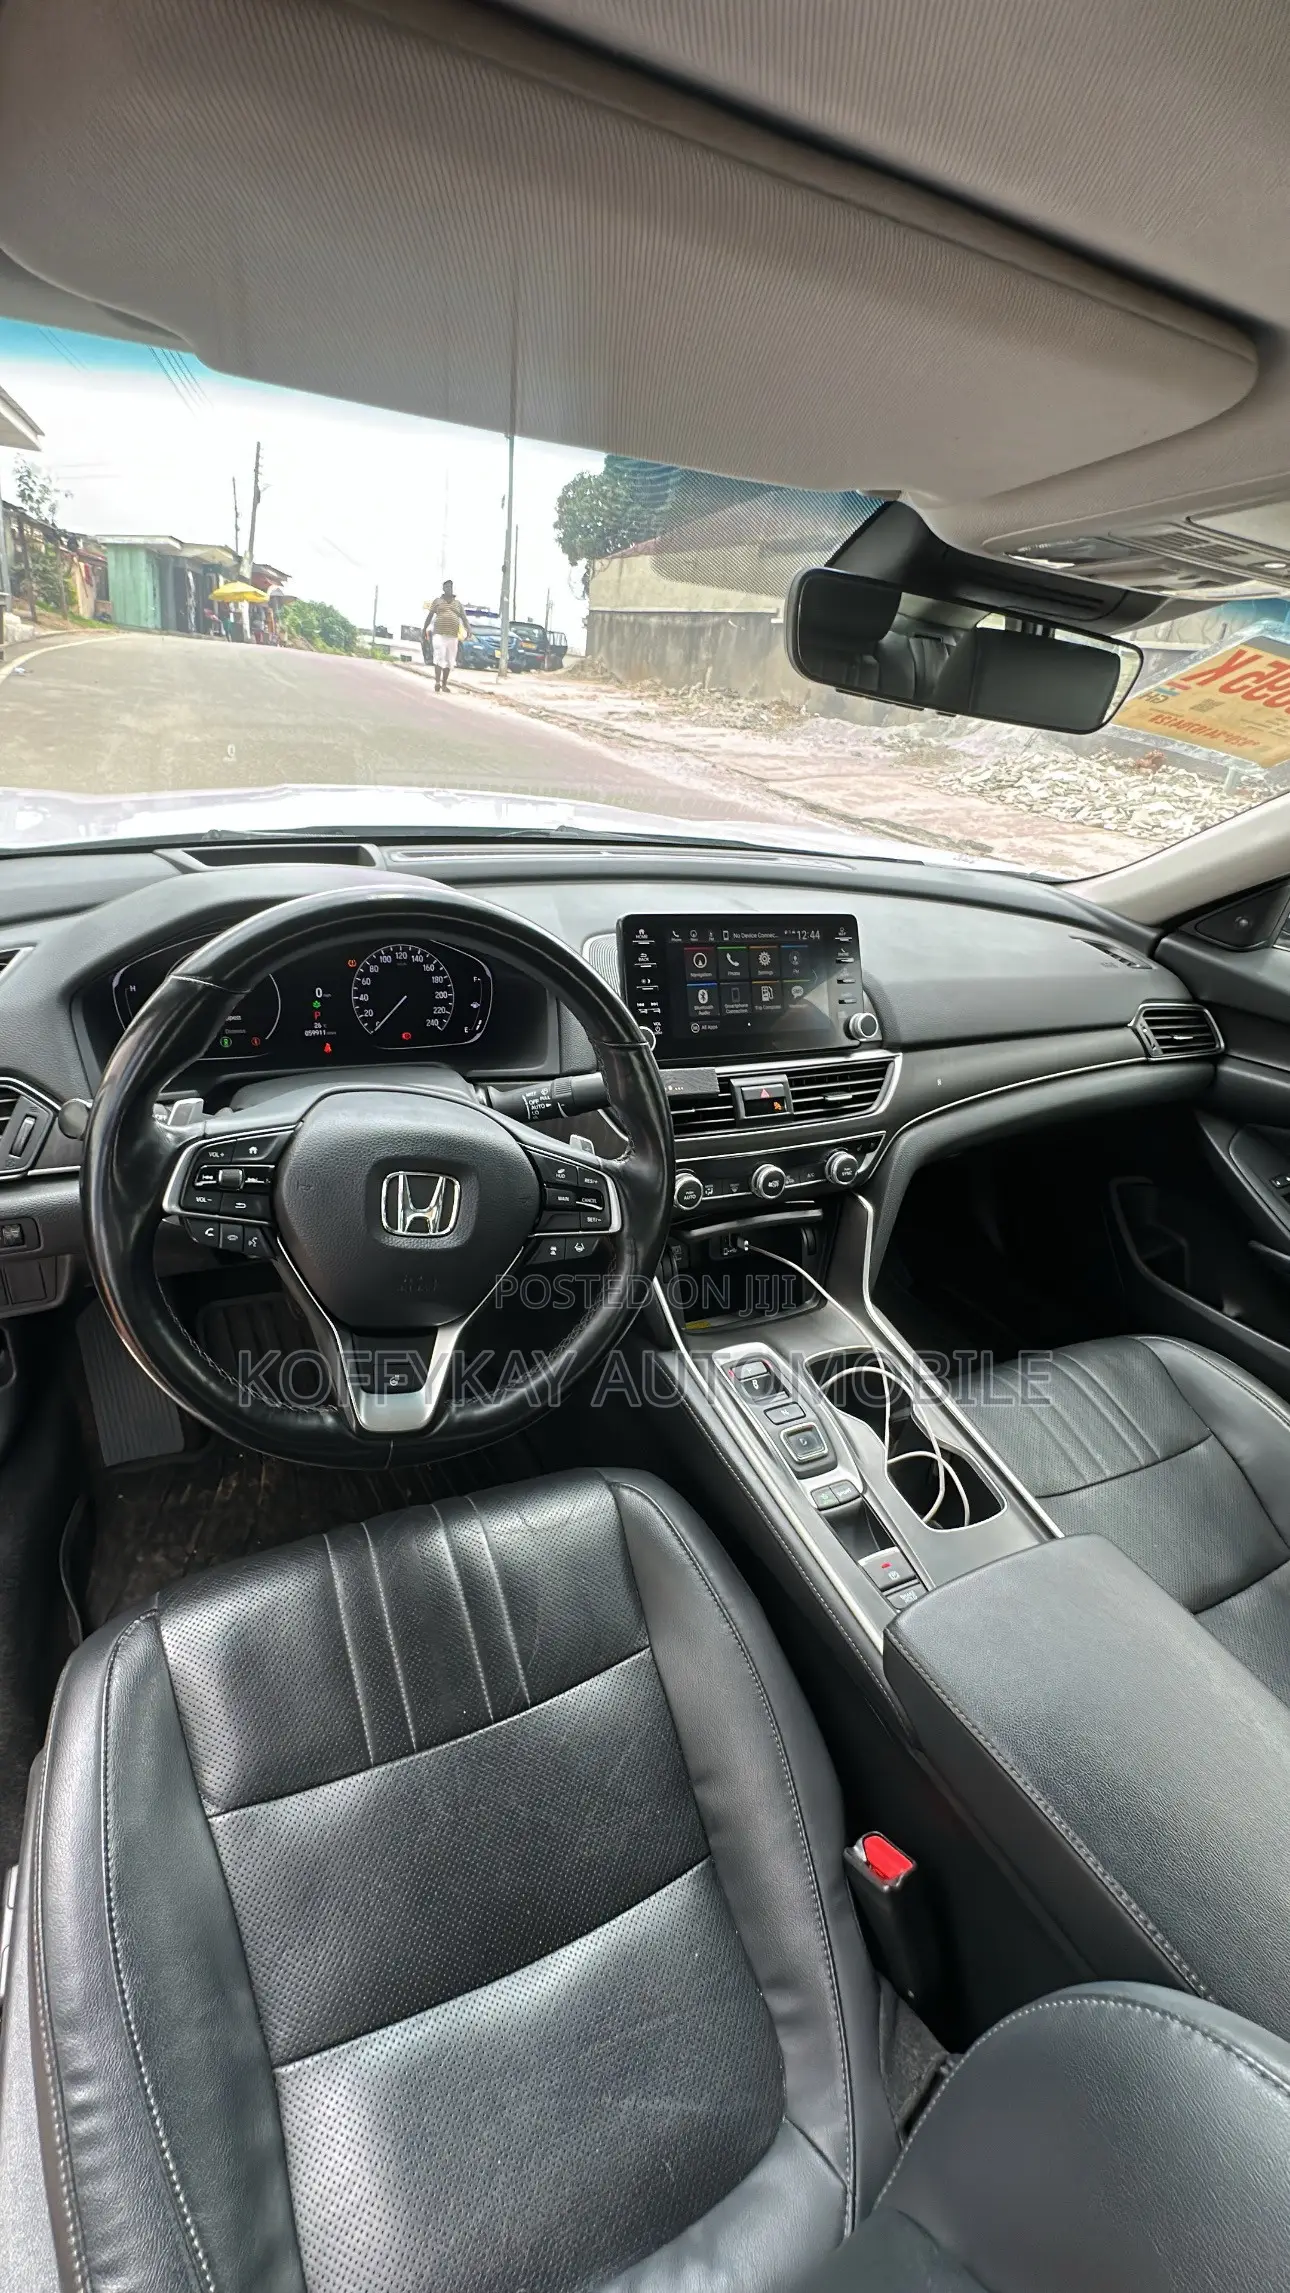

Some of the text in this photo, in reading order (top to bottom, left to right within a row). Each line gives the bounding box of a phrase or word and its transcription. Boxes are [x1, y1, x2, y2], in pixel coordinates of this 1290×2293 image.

[797, 930, 820, 940] 12:44
[379, 956, 392, 964] 100
[369, 965, 379, 973] 80
[423, 964, 434, 972] 160
[362, 978, 371, 986] 60
[316, 988, 322, 998] 0
[434, 991, 448, 999] 200
